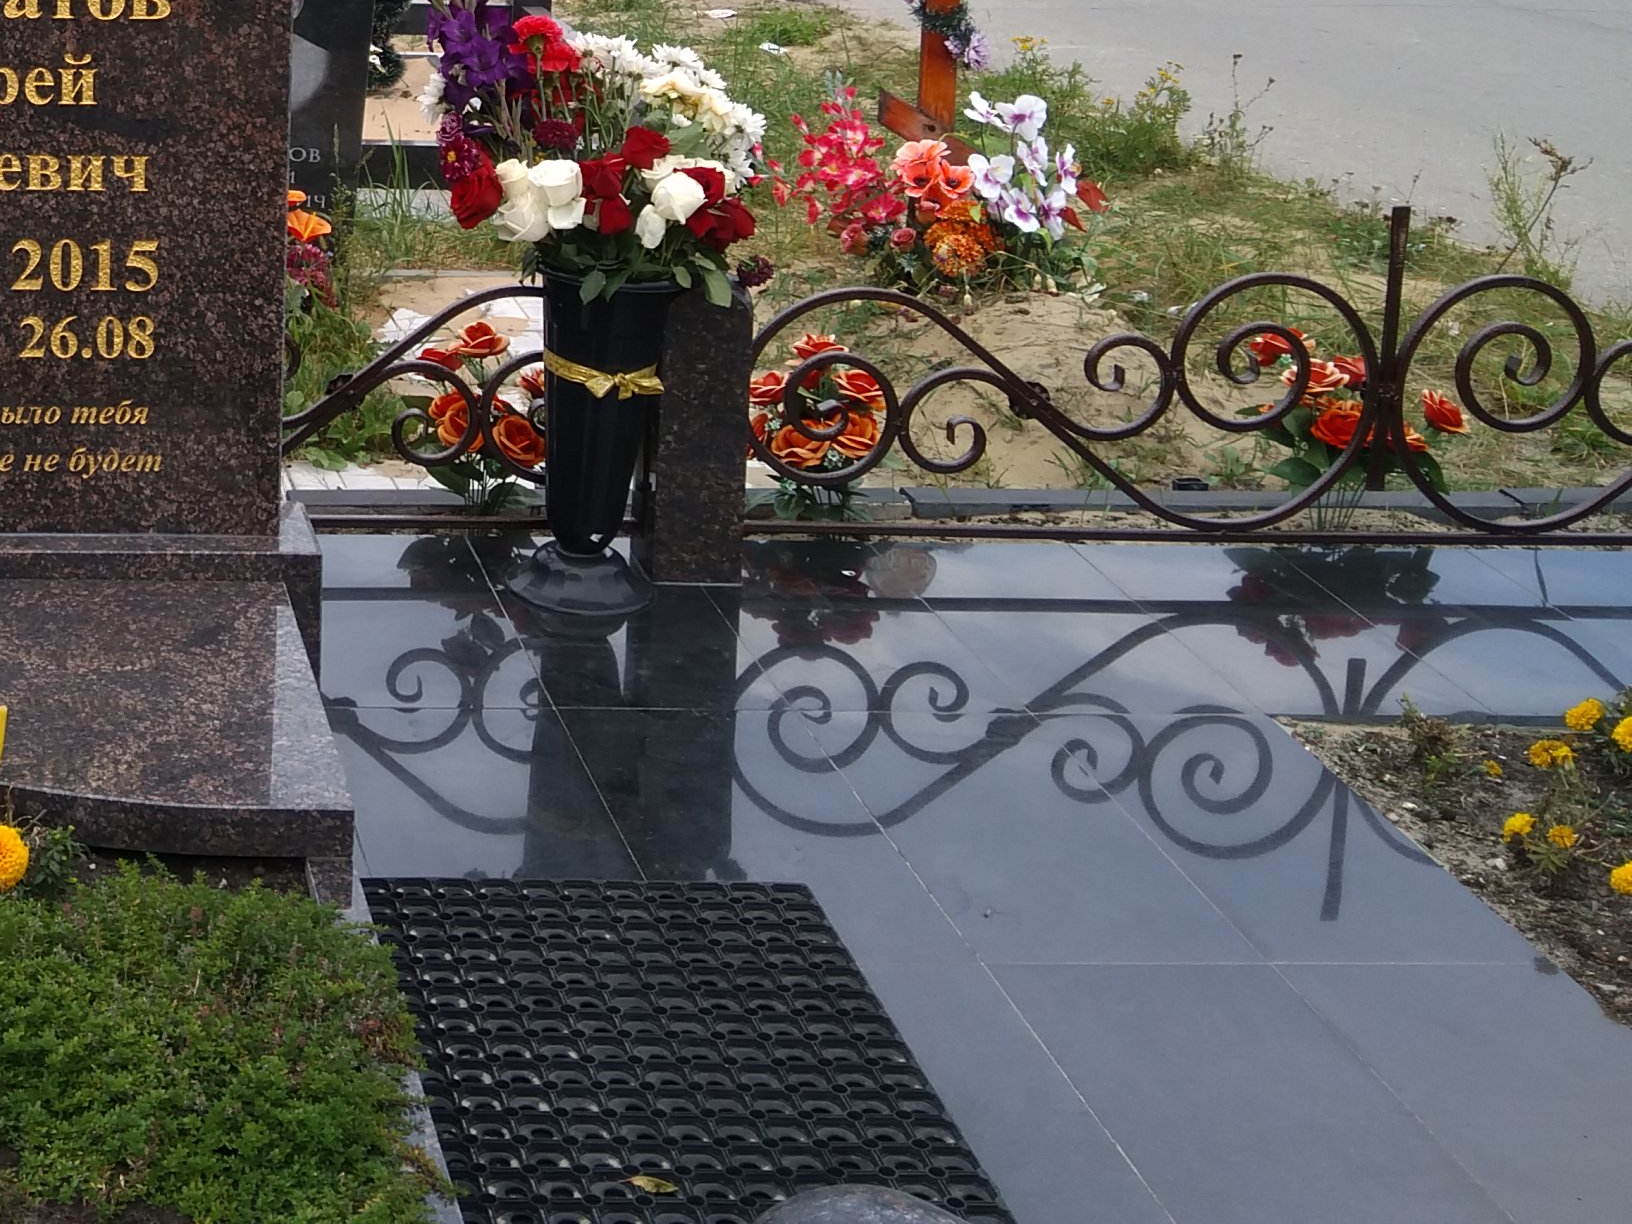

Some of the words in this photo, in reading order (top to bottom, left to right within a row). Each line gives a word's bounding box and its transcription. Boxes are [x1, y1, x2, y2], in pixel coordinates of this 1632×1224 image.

[10, 238, 160, 292] 2015
[19, 316, 155, 359] 26.08
[70, 400, 149, 425] тебя
[24, 454, 60, 473] не
[68, 446, 163, 478] будет
